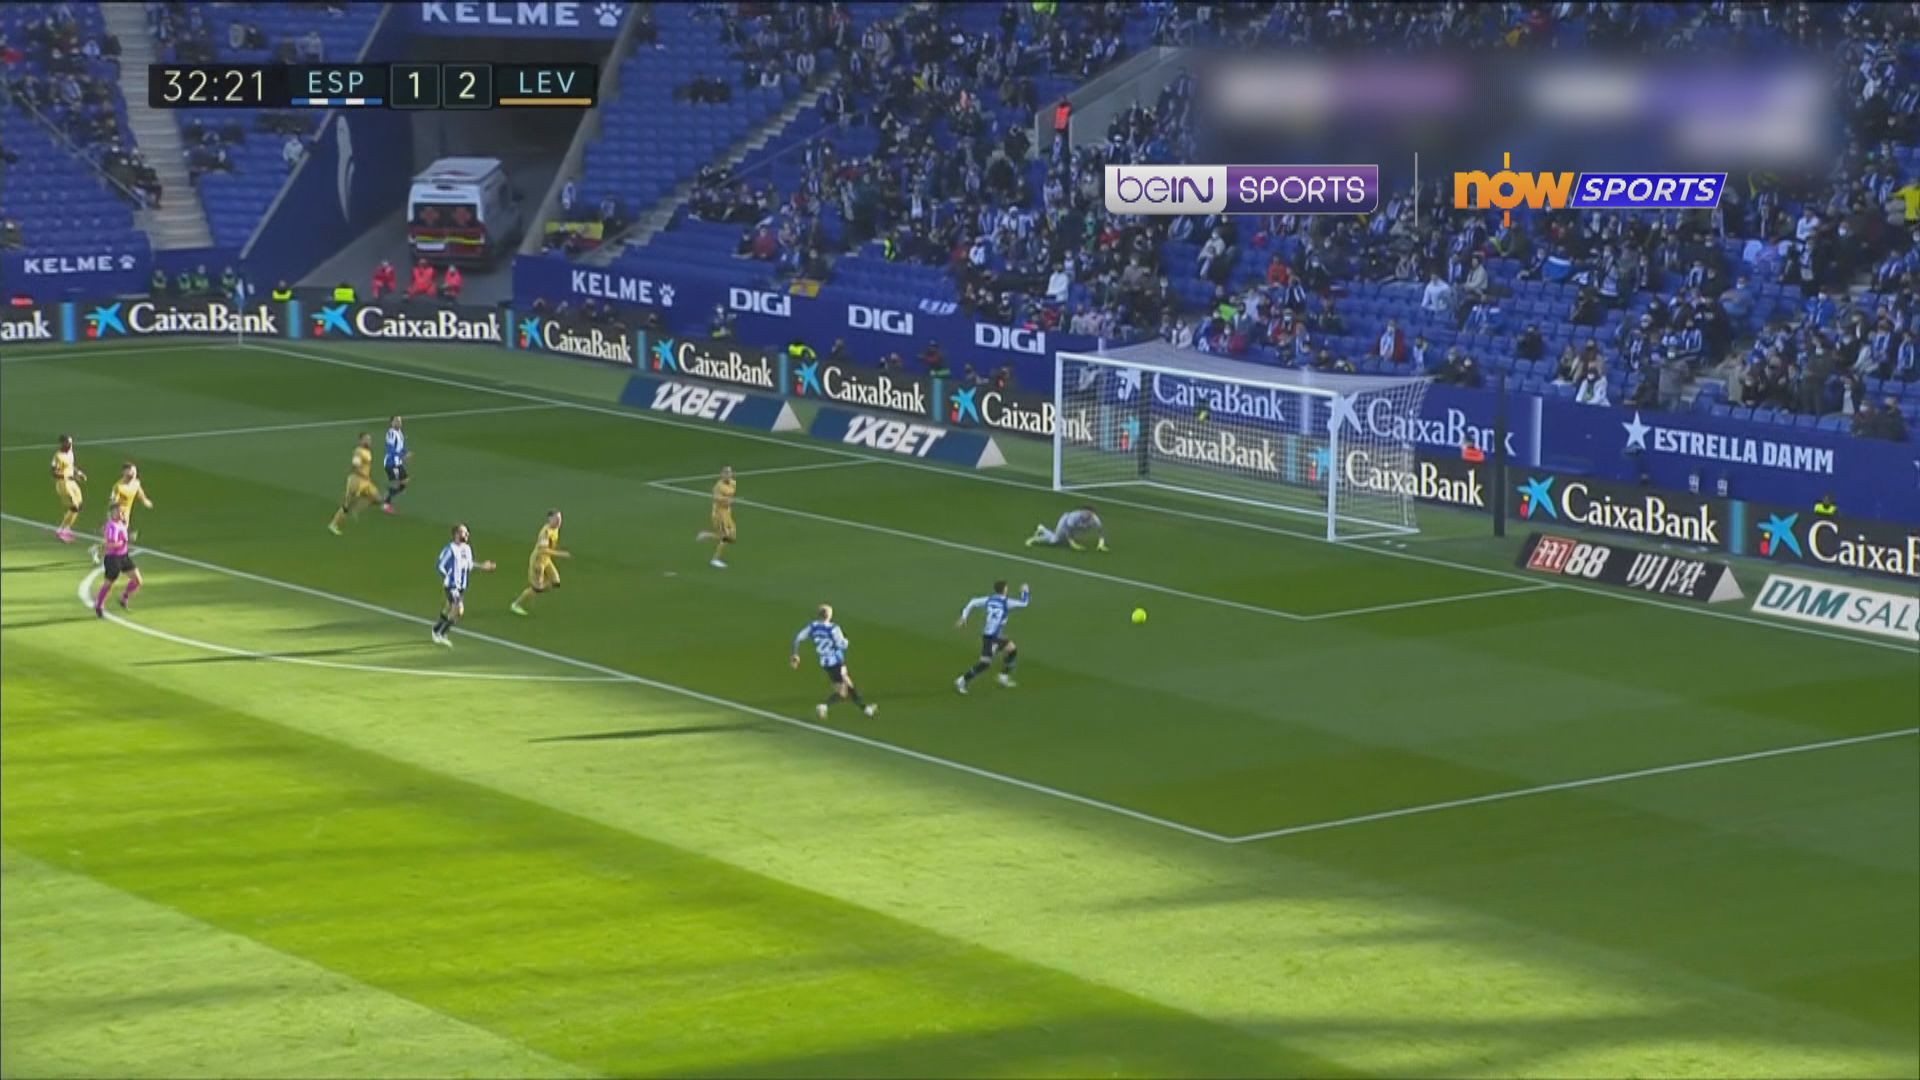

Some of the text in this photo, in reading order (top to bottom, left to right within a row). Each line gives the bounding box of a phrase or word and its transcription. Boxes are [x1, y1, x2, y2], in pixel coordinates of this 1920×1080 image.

[422, 2, 580, 26] KELME
[24, 256, 113, 274] KELME
[571, 269, 653, 304] KELME
[729, 287, 792, 318] DIGI
[128, 302, 278, 334] CaixaBank
[356, 306, 501, 341] CaixaBank
[848, 304, 913, 336] DIGI
[543, 320, 632, 364] CaixaBank
[975, 322, 1046, 355] DIGI
[678, 342, 773, 388] CaixaBank
[650, 381, 747, 422] 1XBET
[823, 366, 926, 415] CaixaBank
[842, 415, 947, 457] 1XBET
[1154, 419, 1279, 472] CaixaBank
[1654, 428, 1834, 474] ESTRELLA DAMM
[1345, 450, 1484, 507] CaixaBank
[1561, 482, 1719, 544] CaixaBank
[1760, 580, 1851, 620] DAM
